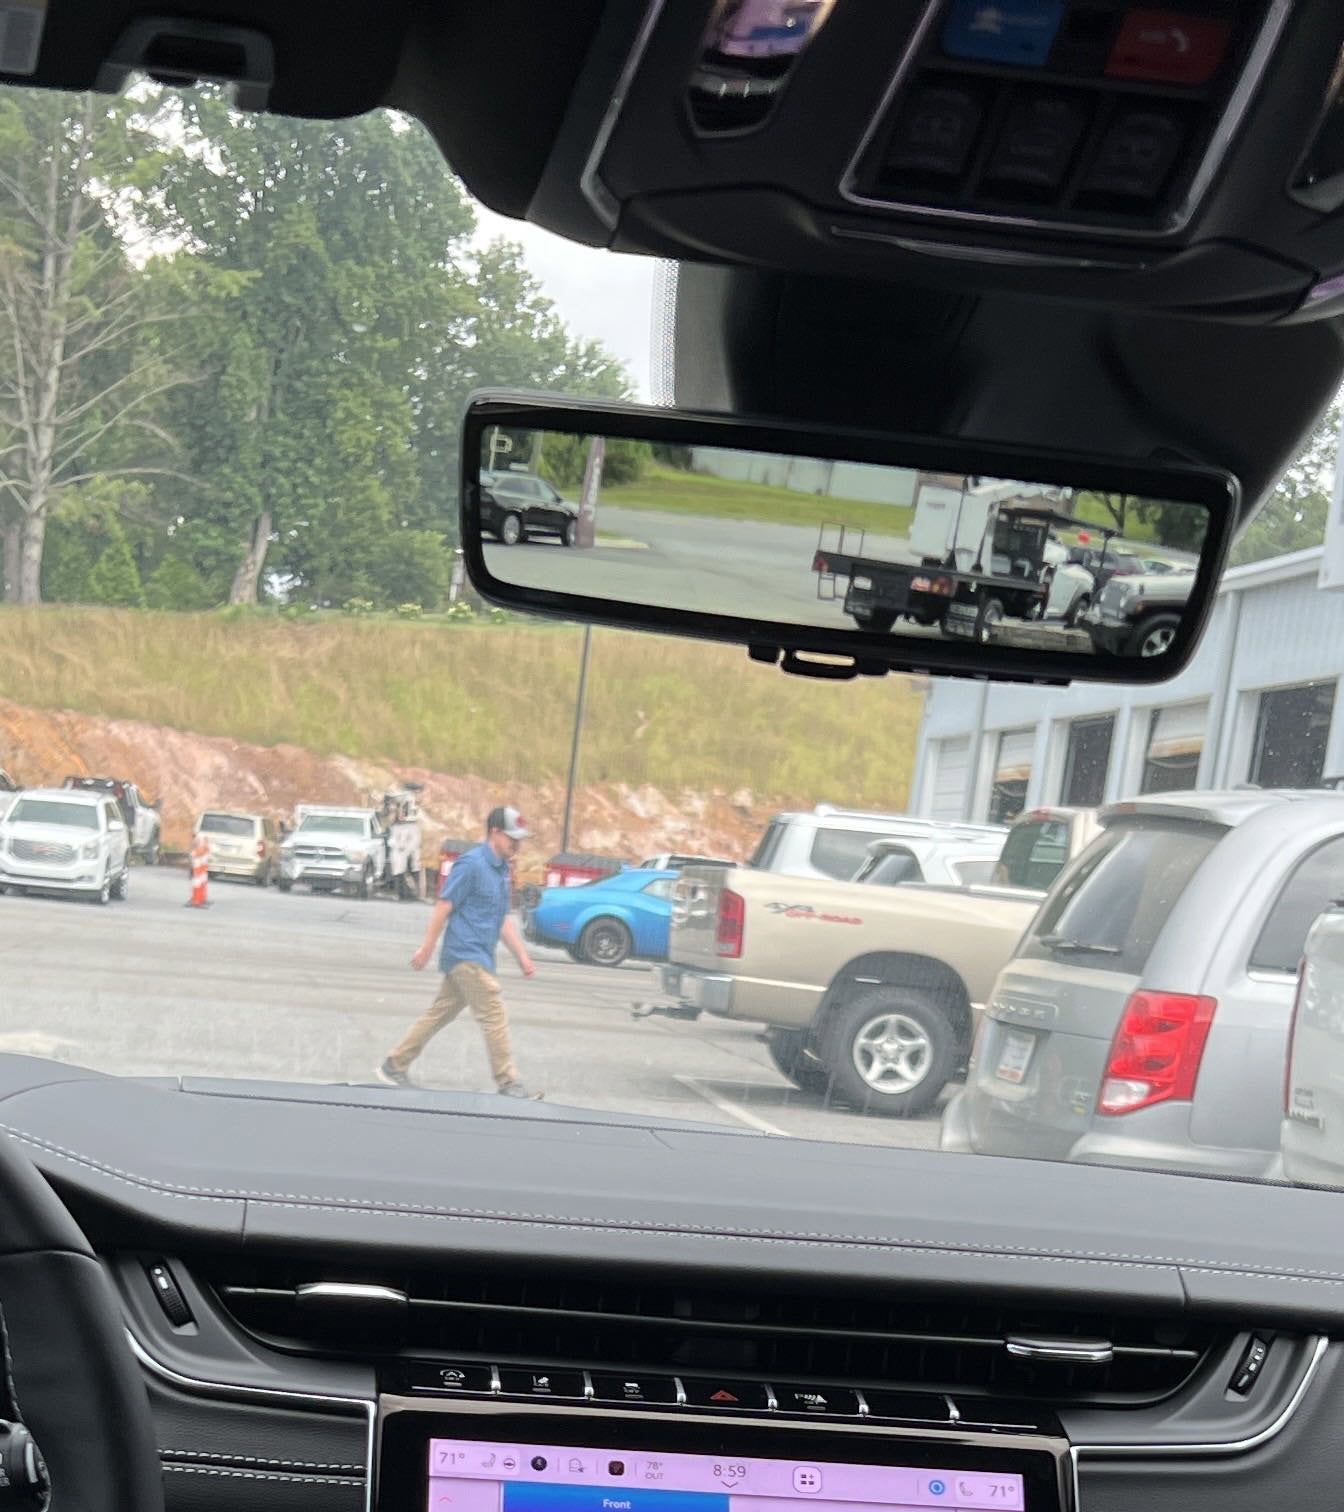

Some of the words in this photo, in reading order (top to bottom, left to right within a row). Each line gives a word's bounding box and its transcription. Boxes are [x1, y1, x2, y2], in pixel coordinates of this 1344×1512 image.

[439, 1452, 465, 1465] 71°
[712, 1464, 746, 1478] 8:59
[988, 1484, 1015, 1498] 71°
[603, 1498, 632, 1510] Front
